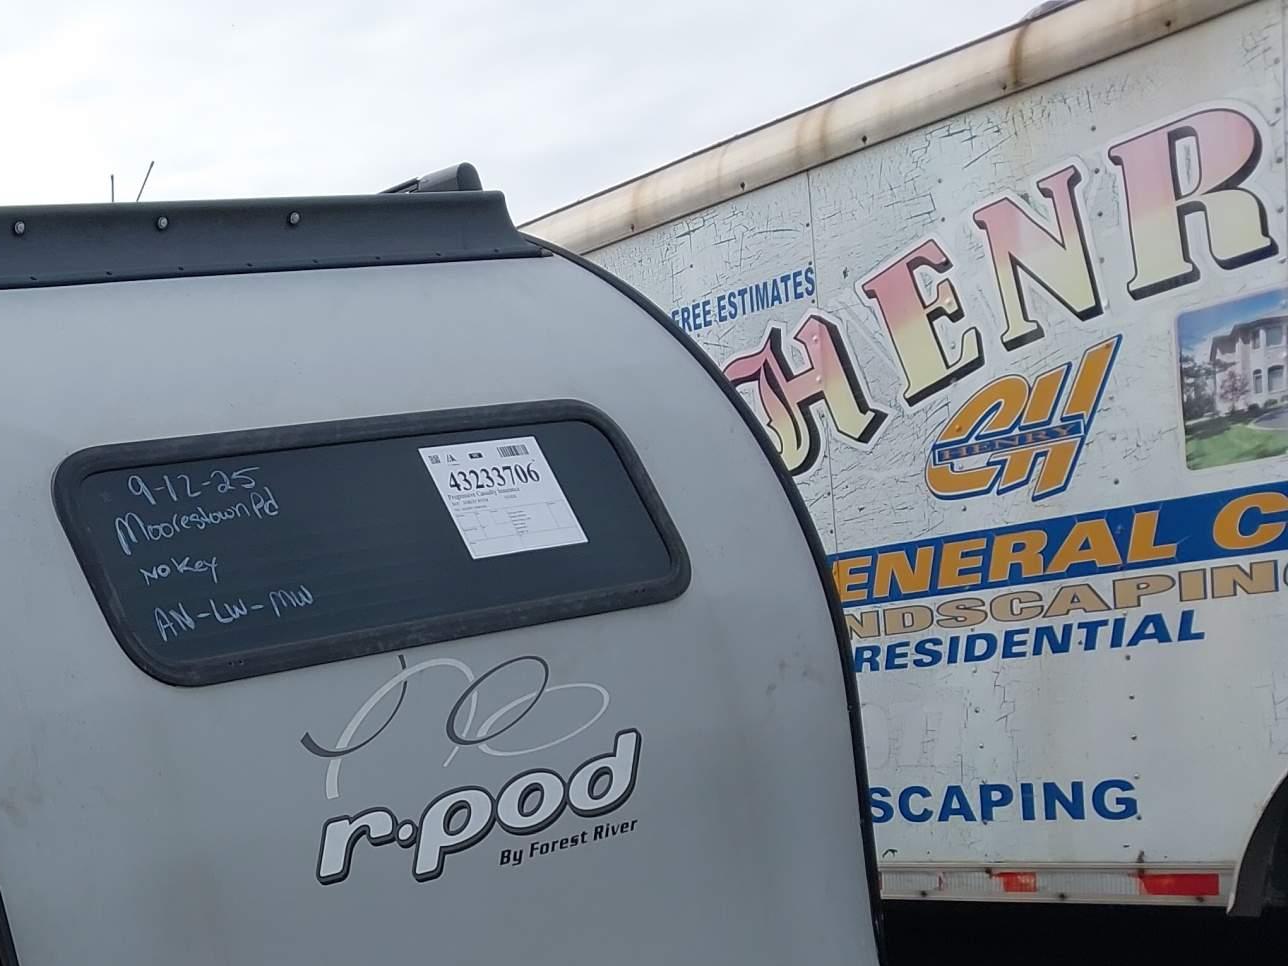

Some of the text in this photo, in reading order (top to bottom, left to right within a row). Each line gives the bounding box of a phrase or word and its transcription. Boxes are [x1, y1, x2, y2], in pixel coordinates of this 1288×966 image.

[671, 267, 816, 332] FREE ESTIMATES
[127, 467, 260, 505] 9-12-25
[448, 462, 540, 492] 43233706
[844, 559, 1288, 640] NDSCAPIN
[854, 609, 1206, 673] RESIDENTIAL
[870, 779, 1138, 825] SCAPING
[500, 819, 638, 866] By Forest River
